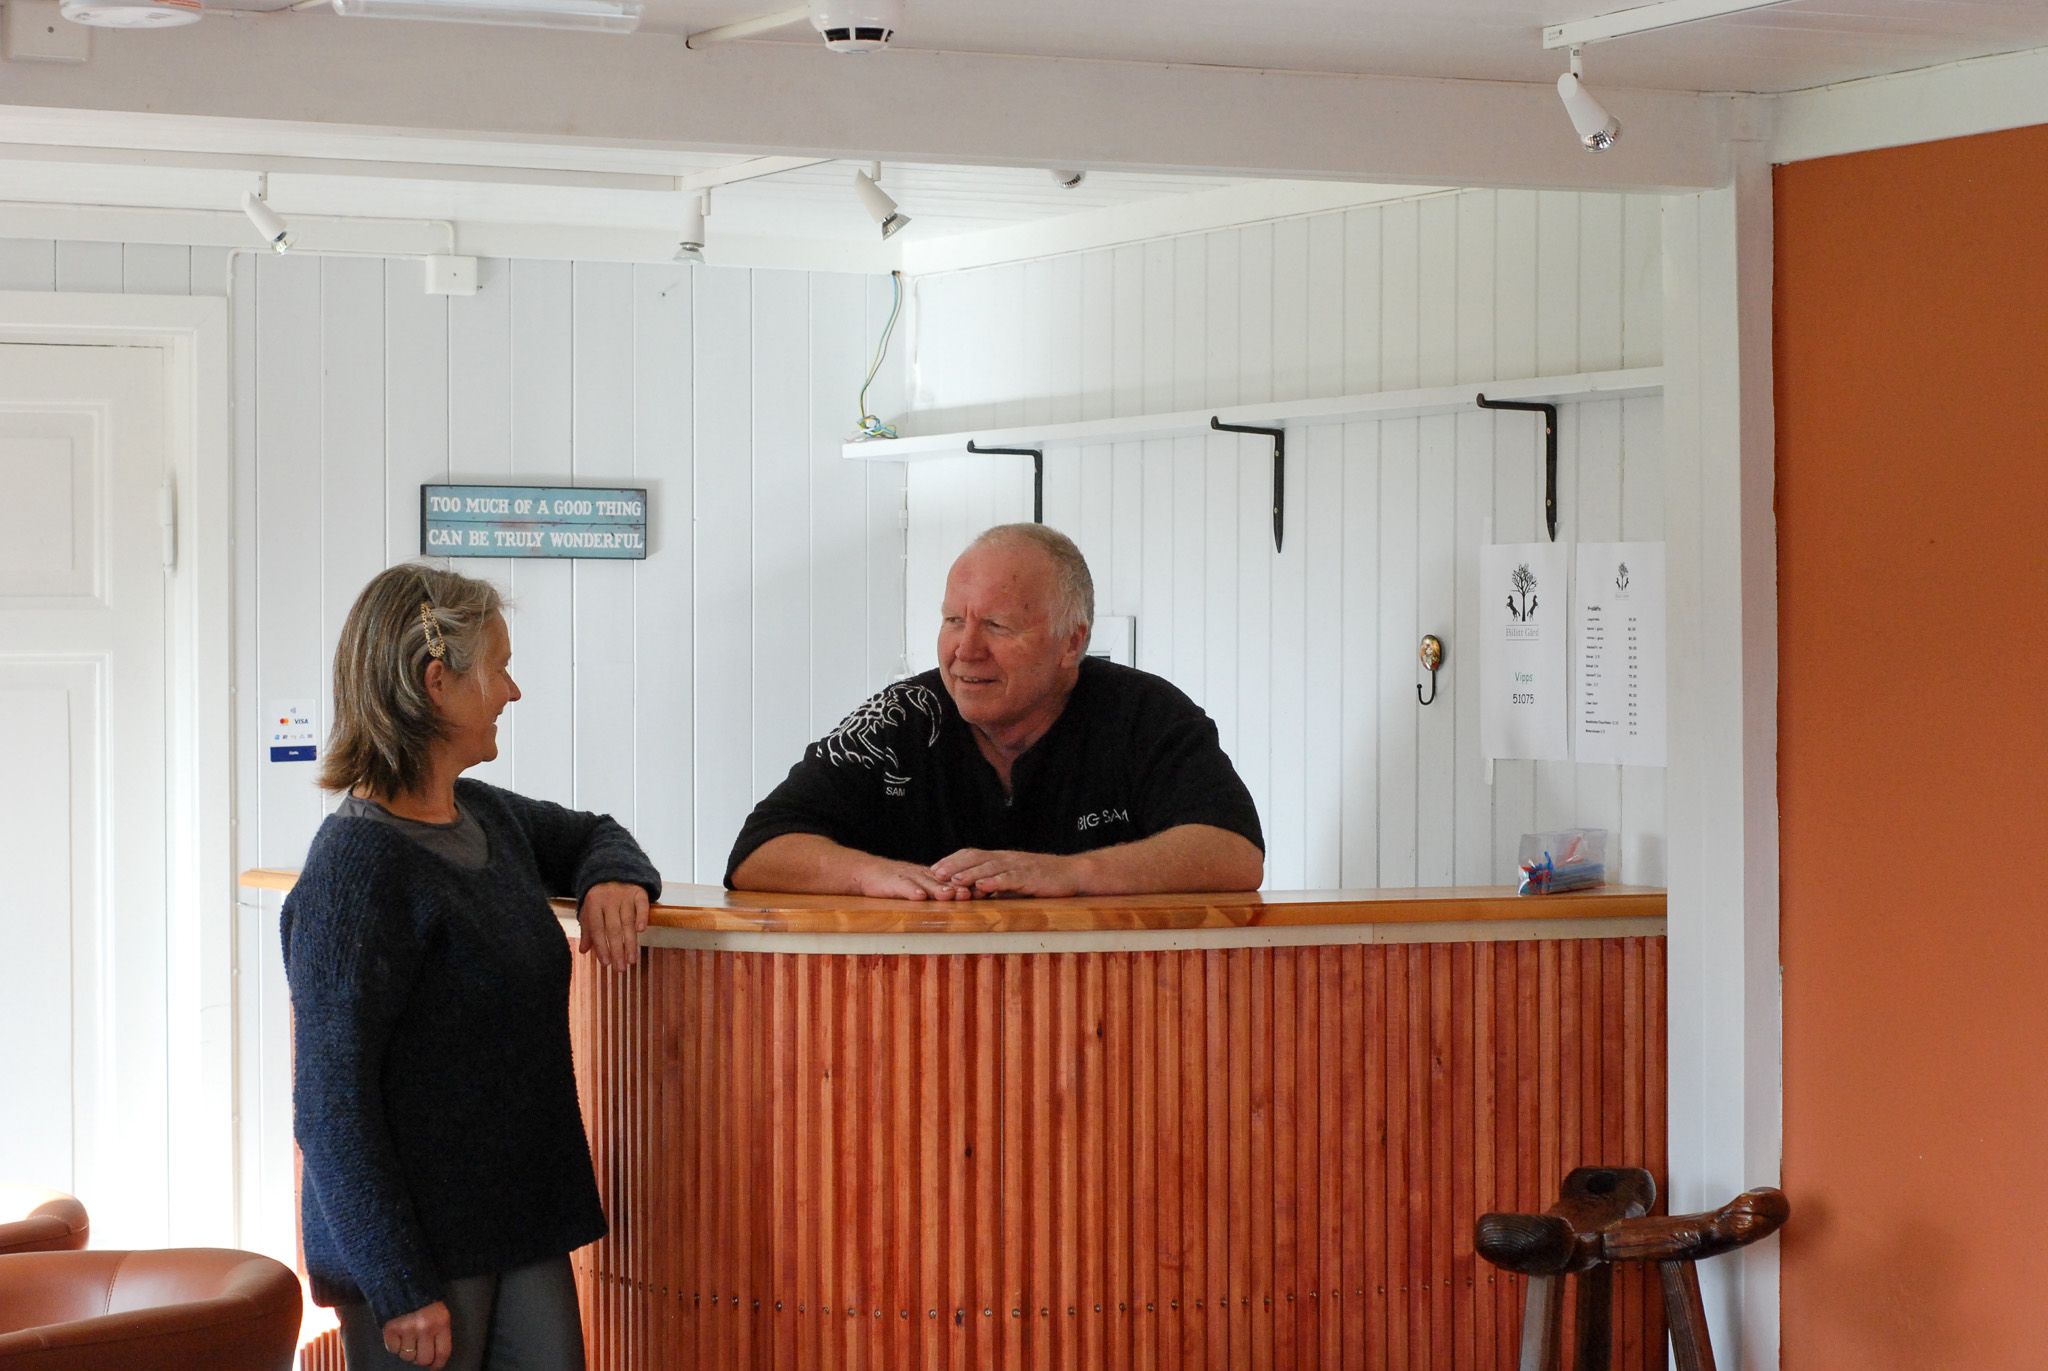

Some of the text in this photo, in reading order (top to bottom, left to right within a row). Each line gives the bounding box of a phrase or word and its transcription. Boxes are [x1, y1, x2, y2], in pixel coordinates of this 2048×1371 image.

[430, 496, 641, 516] TOO MUCH OF A GOOD THING
[428, 529, 643, 549] CAN BE TRULY WONDERFUL
[1514, 672, 1533, 684] Vipps
[1512, 694, 1535, 704] 51075
[1077, 812, 1100, 831] BIG
